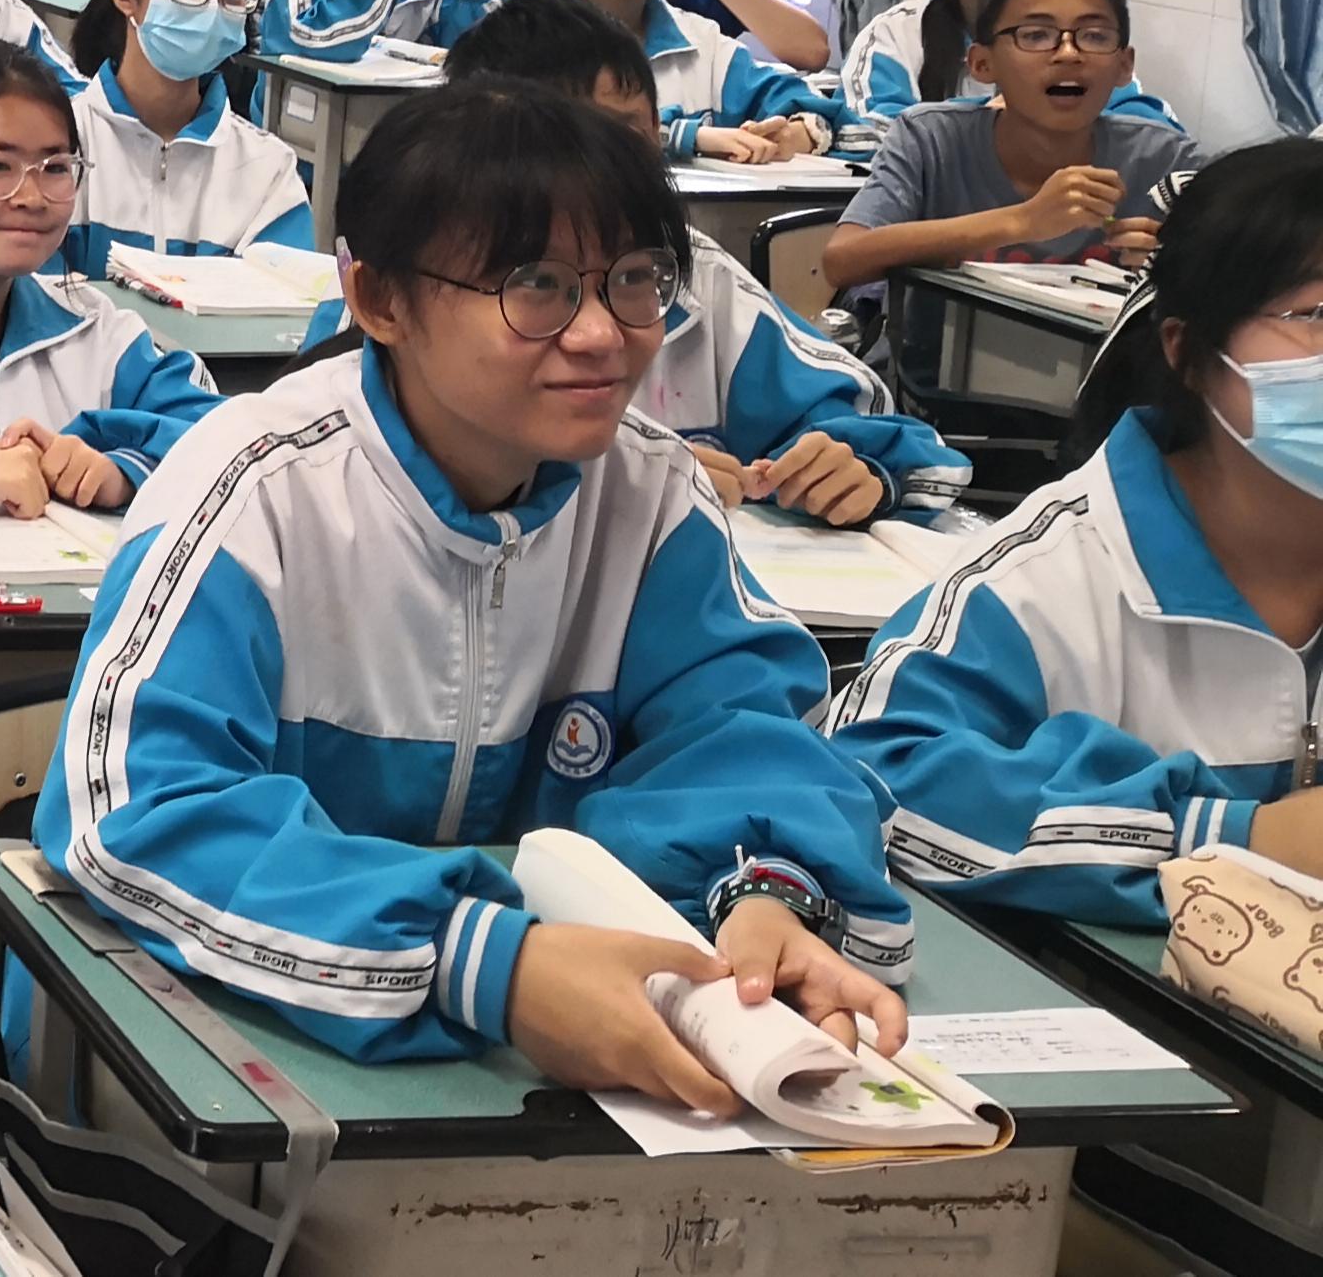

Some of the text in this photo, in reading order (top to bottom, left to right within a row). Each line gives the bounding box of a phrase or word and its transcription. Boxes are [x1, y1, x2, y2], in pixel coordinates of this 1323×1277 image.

[217, 458, 246, 499] SPORT
[165, 539, 192, 586] SPORT
[92, 712, 106, 756] SPORT
[1099, 830, 1152, 843] SPORT
[928, 849, 980, 875] SPORT
[109, 881, 165, 911] SPORT
[1245, 902, 1285, 940] Bear
[252, 950, 298, 973] SPORT
[363, 974, 424, 987] SPORT
